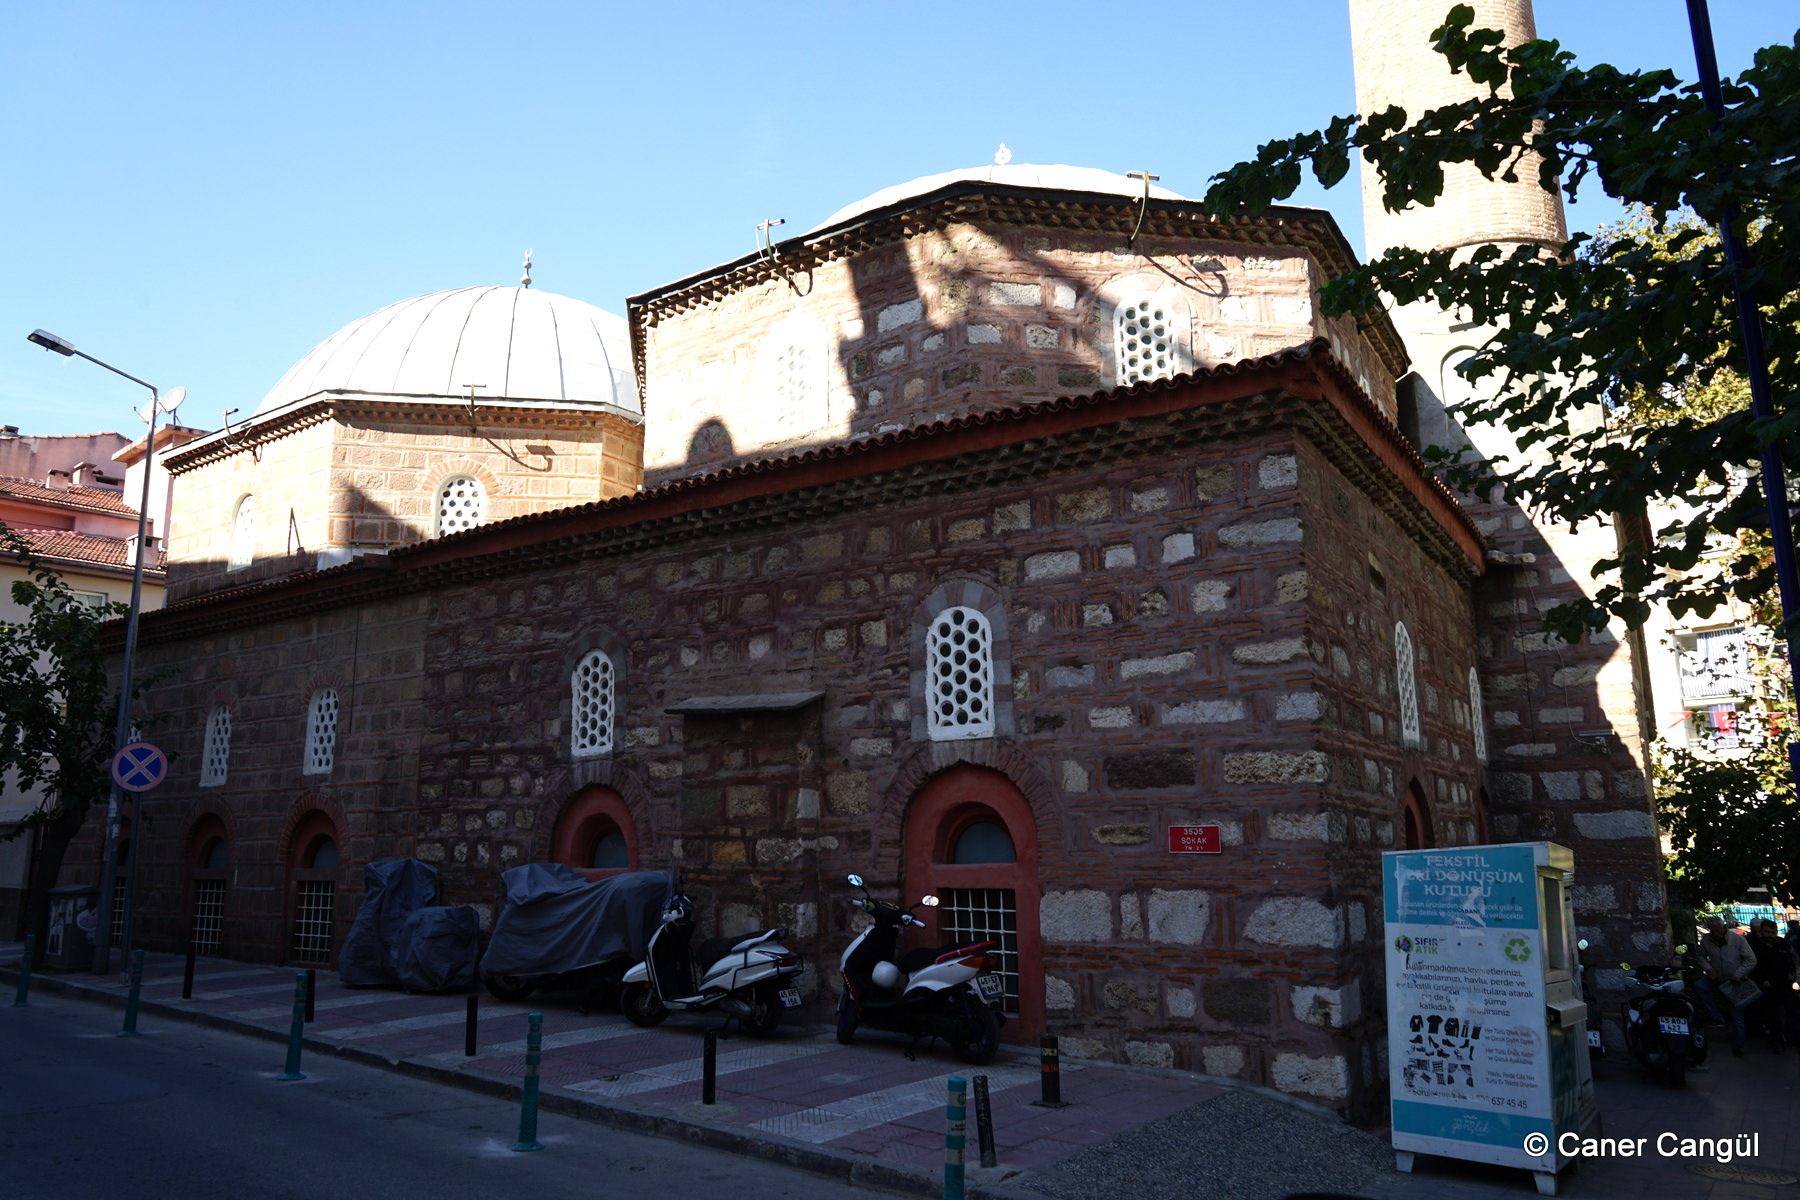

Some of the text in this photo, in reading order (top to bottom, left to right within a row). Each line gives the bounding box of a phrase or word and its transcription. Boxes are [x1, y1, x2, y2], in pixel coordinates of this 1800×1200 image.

[1181, 837, 1207, 845] SOKAK
[1423, 854, 1490, 868] TEKSTİL
[1436, 868, 1524, 885] DÖNÜŞÜM
[1415, 937, 1438, 946] SIFIR
[1415, 944, 1438, 954] ATIK
[1490, 978, 1514, 987] perde
[1508, 990, 1534, 998] atarak
[1491, 1096, 1504, 1106] 637
[1506, 1098, 1516, 1108] 45
[1517, 1100, 1528, 1109] 45
